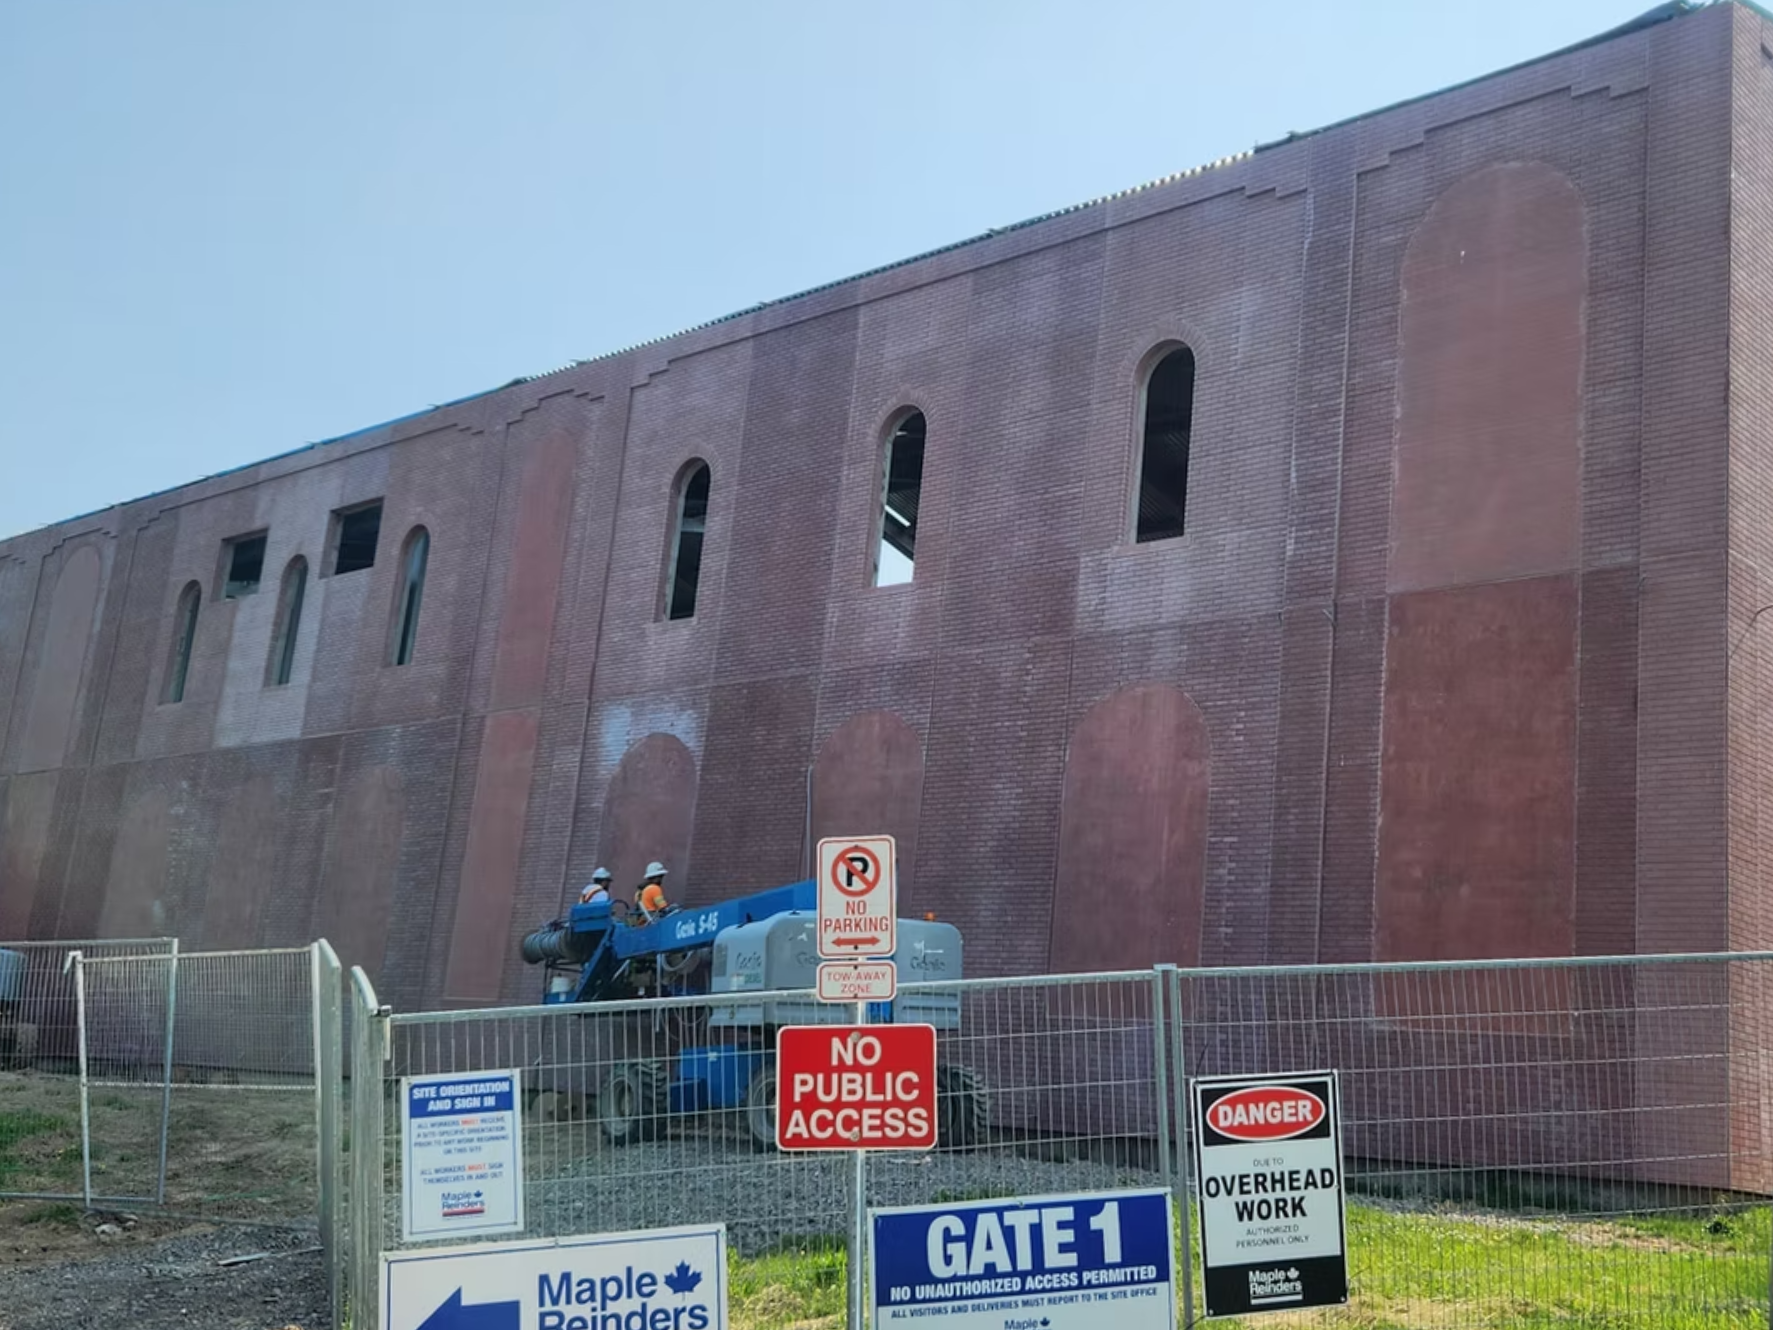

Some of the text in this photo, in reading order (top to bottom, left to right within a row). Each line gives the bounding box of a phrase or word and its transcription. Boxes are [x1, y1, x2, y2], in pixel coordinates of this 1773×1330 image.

[845, 900, 867, 916] NO
[824, 916, 889, 934] PARKING
[827, 971, 887, 982] TOW-AWAY
[841, 983, 872, 994] ZONE
[831, 1036, 882, 1066] NO
[412, 1081, 510, 1099] SITE ORIENTATION
[794, 1071, 920, 1102] PUBLIC
[427, 1096, 496, 1112] AND SIGN IN
[1218, 1099, 1314, 1128] DANGER
[785, 1107, 929, 1140] ACCESS
[1253, 1157, 1284, 1167] DUE TO
[1205, 1168, 1335, 1198] OVERHEAD
[441, 1191, 472, 1201] Maple
[1235, 1196, 1307, 1222] WORK
[1246, 1224, 1299, 1236] AUTHORIZED
[926, 1201, 1122, 1279] GATE 1
[1236, 1235, 1310, 1248] PERSONNEL ONLY
[890, 1265, 1157, 1302] NO UNAUTHORIZED ACCESS PERMITTED
[1249, 1268, 1286, 1283] Maple
[538, 1266, 658, 1311] Maple
[1250, 1280, 1302, 1296] Reinders
[891, 1287, 1157, 1319] ALL VISITORS AND DELIVERIES MUST REPORT TO THE SITE OFFICE
[538, 1302, 709, 1330] Reinders
[1004, 1318, 1038, 1330] Maple
